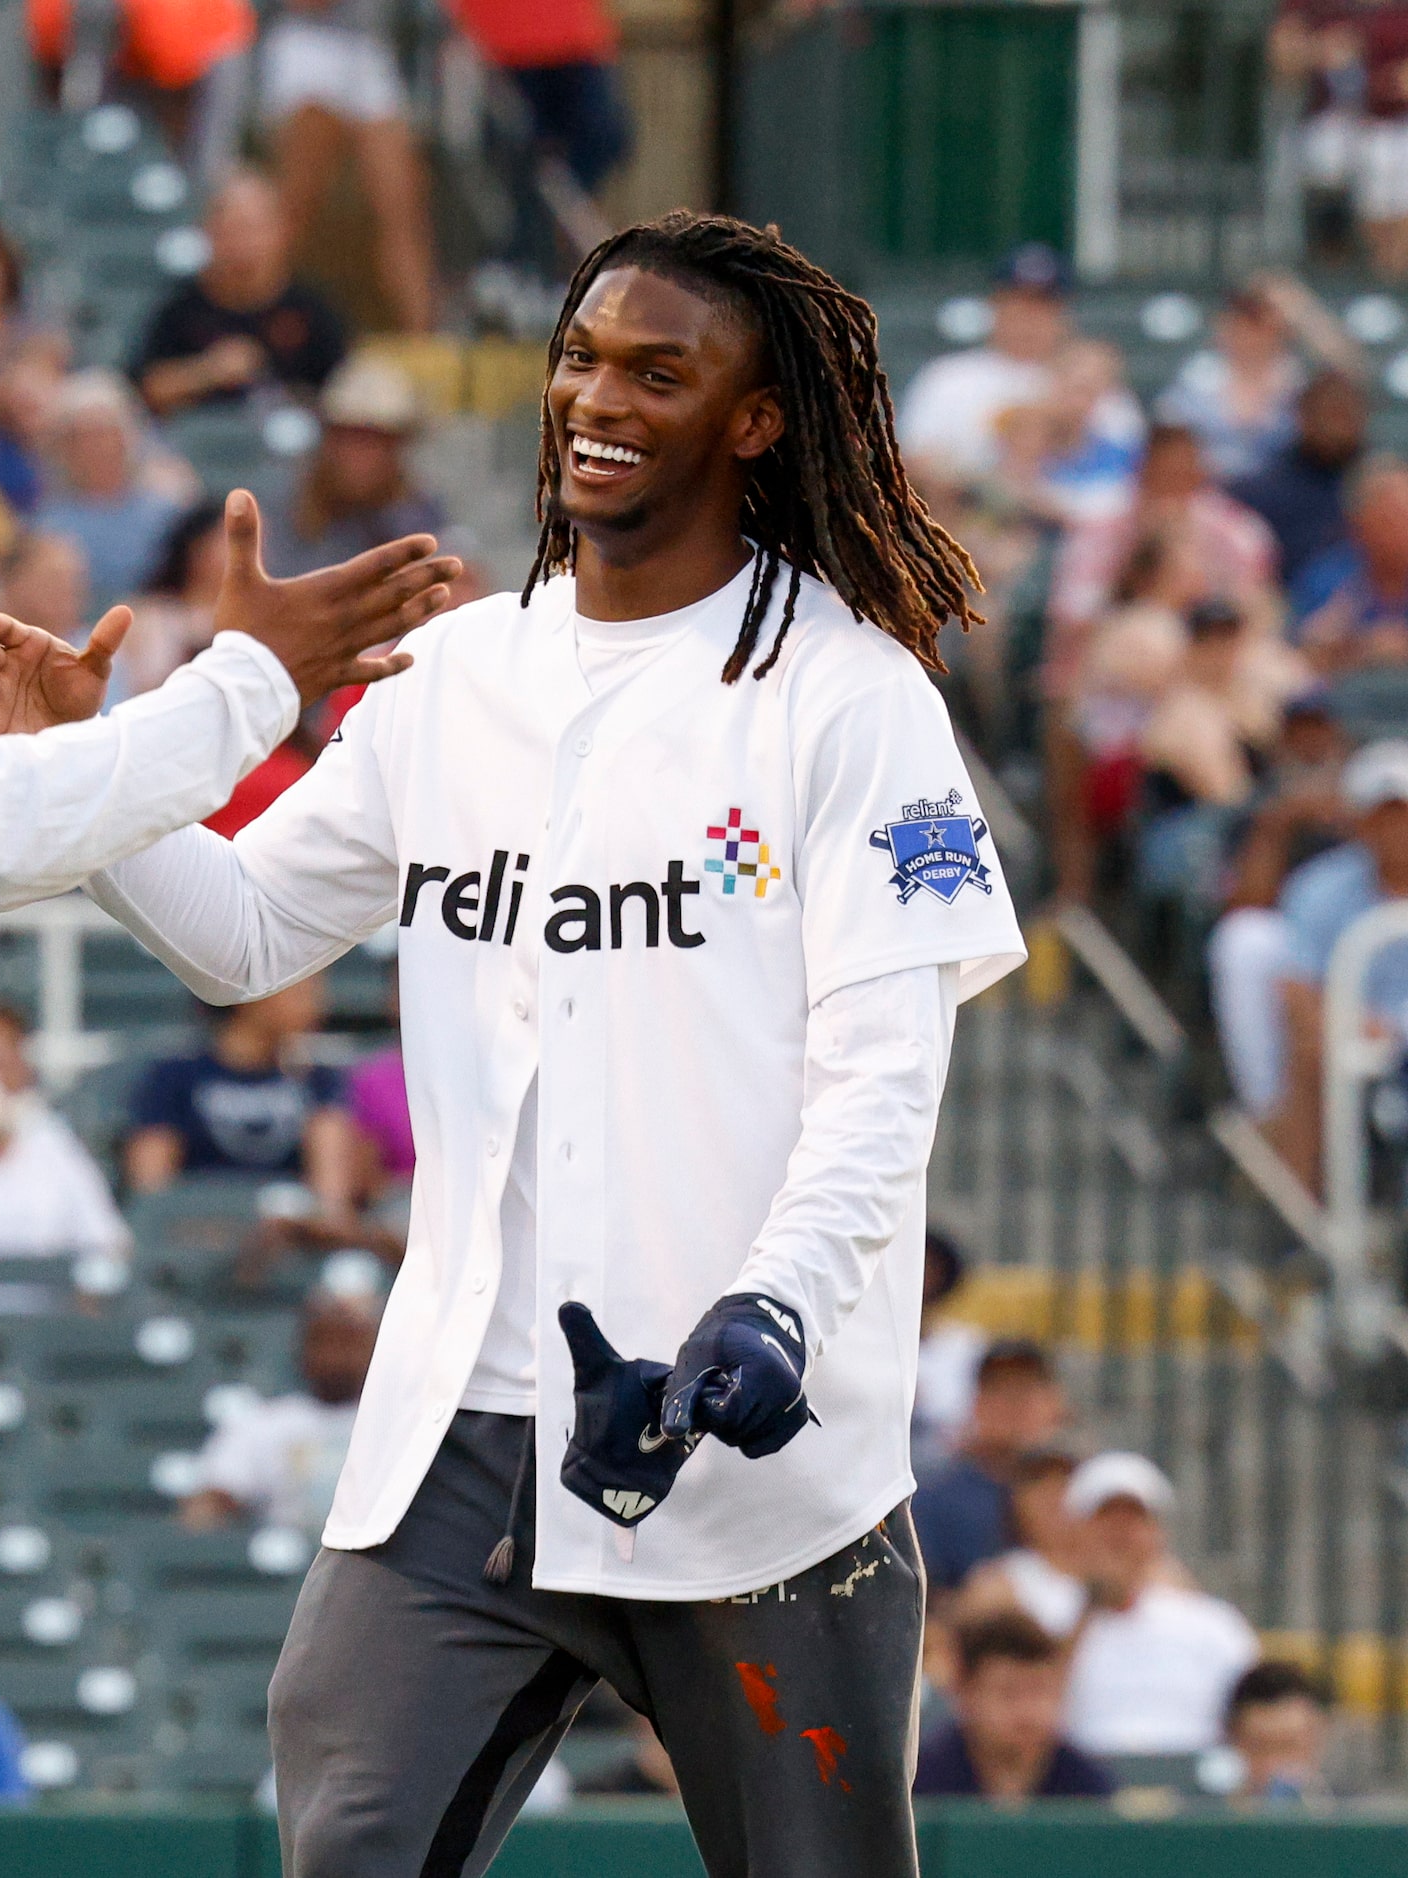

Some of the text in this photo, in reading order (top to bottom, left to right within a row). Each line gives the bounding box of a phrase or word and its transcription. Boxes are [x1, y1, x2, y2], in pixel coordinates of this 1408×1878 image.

[903, 799, 955, 819] reliant
[905, 851, 972, 873] HOME RUN
[922, 866, 962, 881] DERBY
